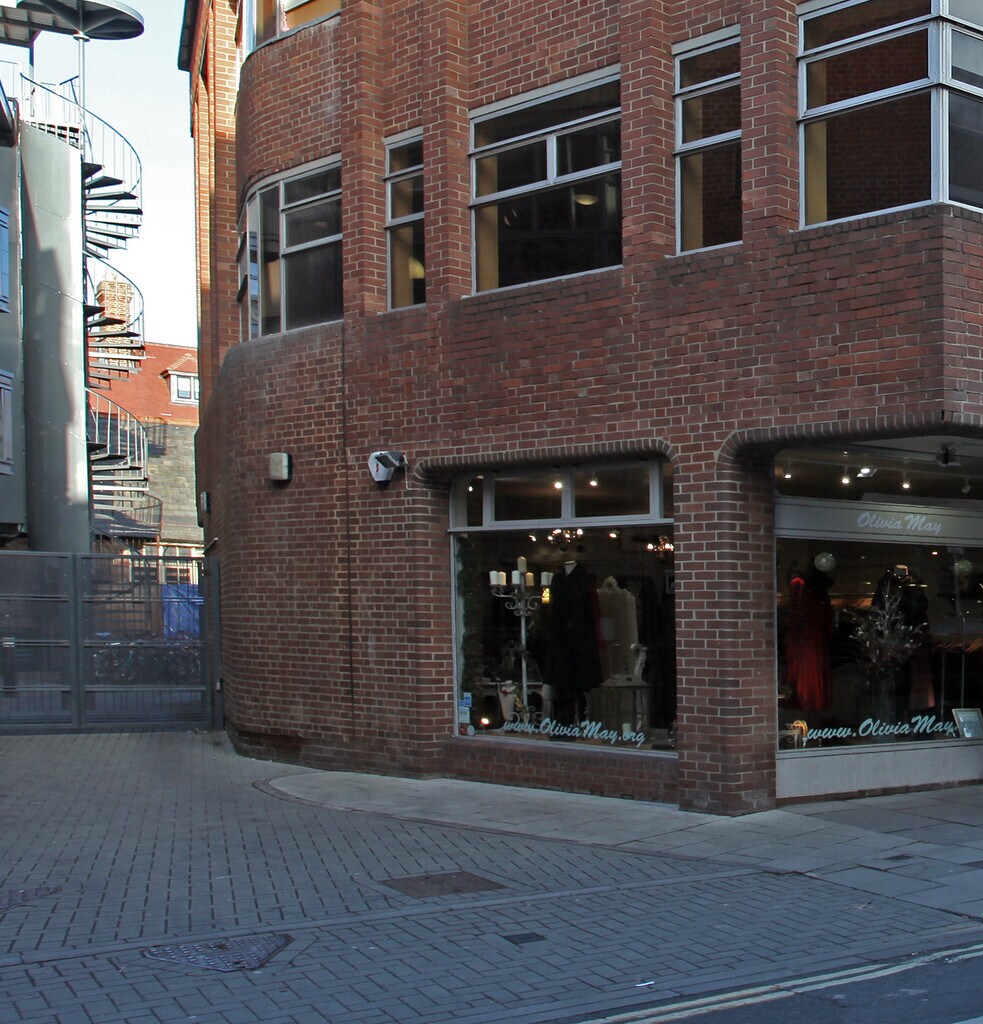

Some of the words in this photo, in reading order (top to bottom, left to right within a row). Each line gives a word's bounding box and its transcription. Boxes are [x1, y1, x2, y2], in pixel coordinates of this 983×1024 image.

[857, 511, 903, 529] Olivia
[904, 514, 943, 535] May
[503, 718, 646, 748] www.OliviaMay.org
[807, 715, 959, 739] www.OliviaMay.
